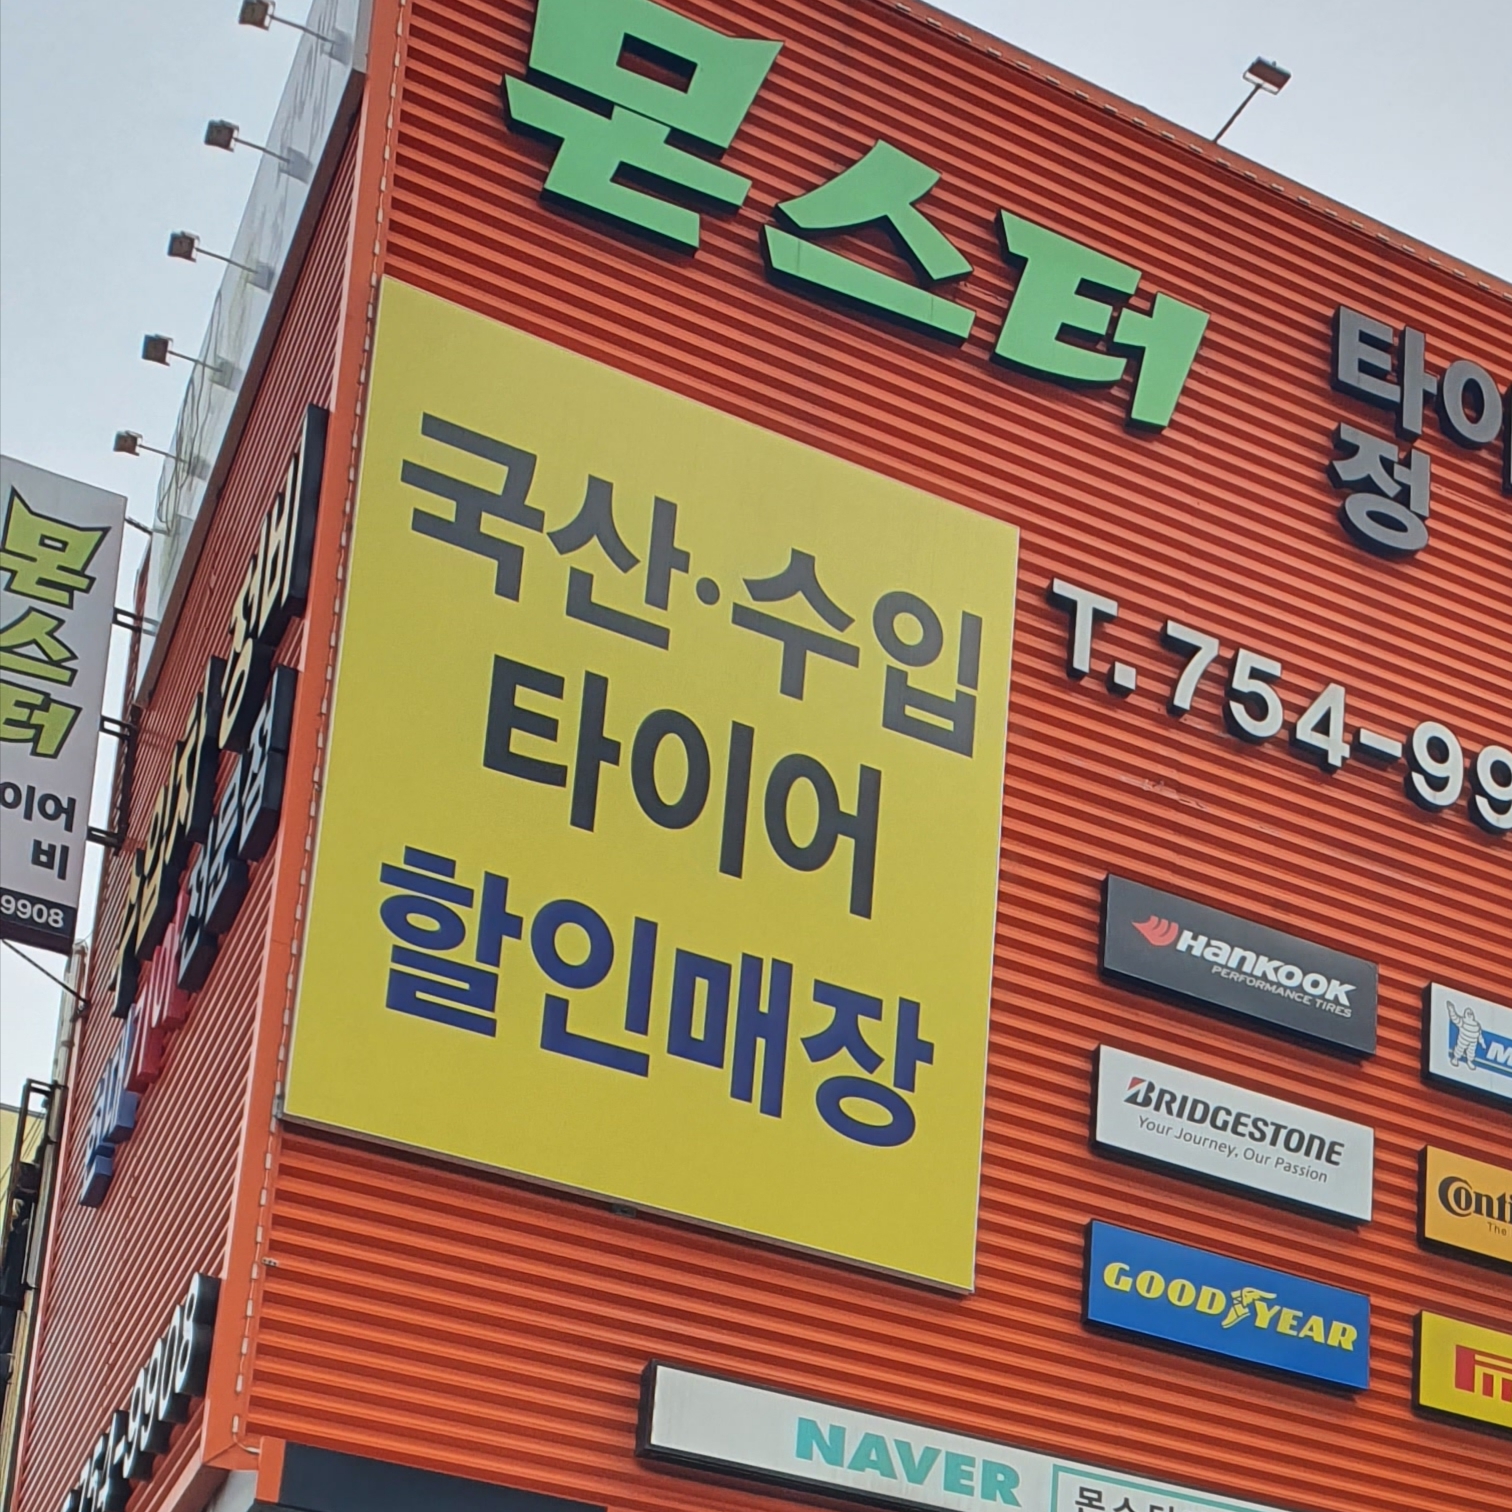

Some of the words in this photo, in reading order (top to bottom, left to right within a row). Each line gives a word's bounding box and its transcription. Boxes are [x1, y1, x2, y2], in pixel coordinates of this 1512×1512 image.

[505, 0, 1210, 429] 몬스터
[219, 405, 309, 750] 정비
[483, 654, 882, 919] 타이어
[31, 840, 69, 881] 비
[380, 845, 935, 1147] 할인매장
[1211, 964, 1312, 1006] PERFORMANCE
[1313, 998, 1353, 1019] TIRES
[1123, 1076, 1346, 1167] BRIDGESTONE
[1137, 1115, 1174, 1138] Your
[1242, 1146, 1272, 1167] Our
[1273, 1156, 1329, 1184] Passion
[1486, 1221, 1508, 1237] The
[794, 1416, 1023, 1508] NAVER
